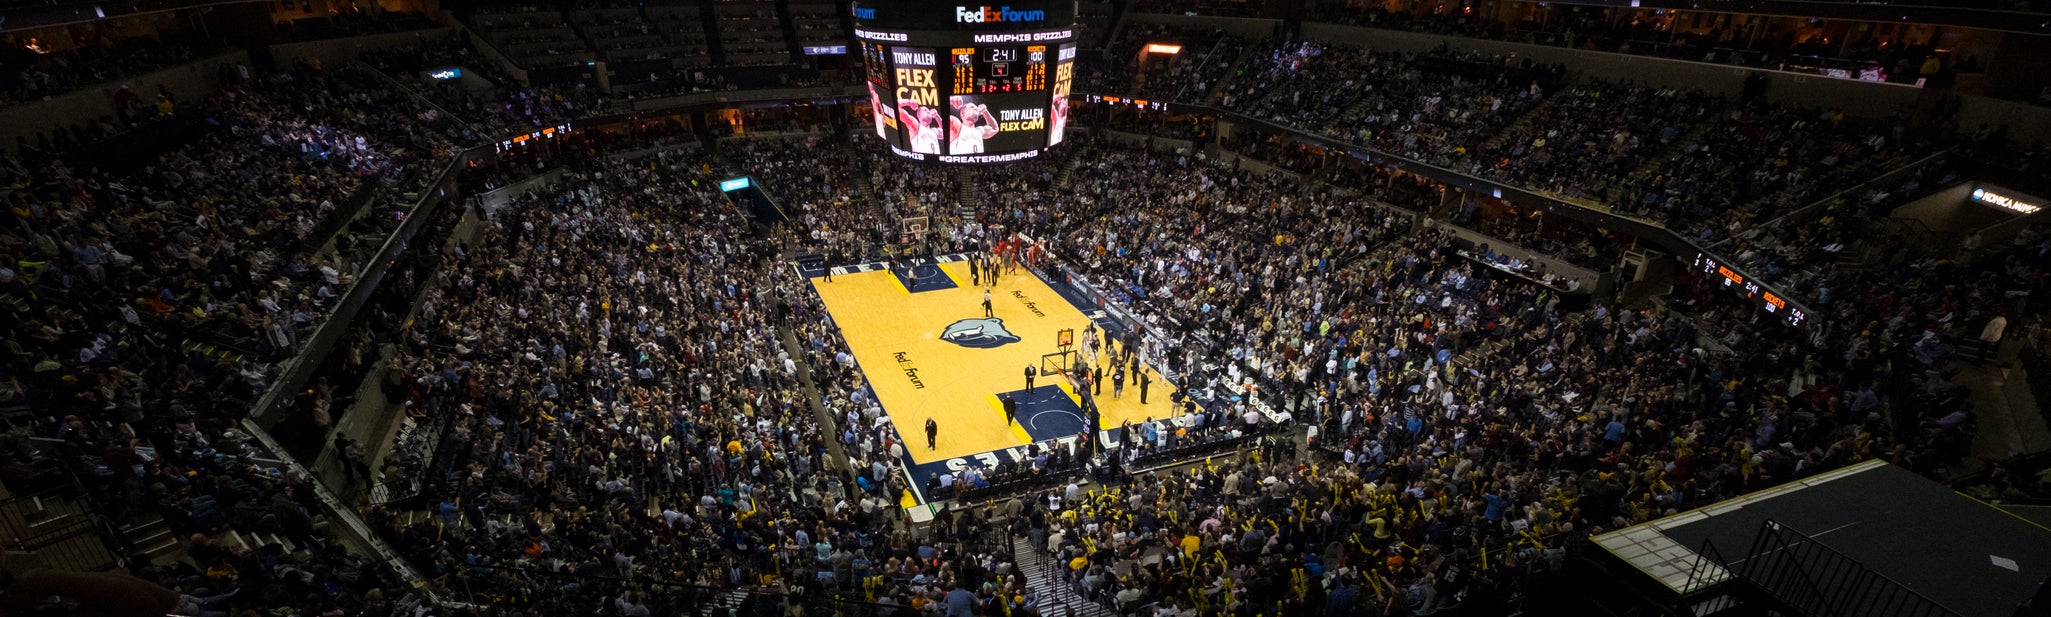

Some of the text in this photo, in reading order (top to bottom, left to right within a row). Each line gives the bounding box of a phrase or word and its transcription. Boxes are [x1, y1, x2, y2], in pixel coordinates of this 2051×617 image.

[956, 6, 1045, 22] FedExForum
[865, 31, 908, 41] GRIZZLIES
[974, 30, 1072, 43] MEMPHIS GRIZZLIES
[893, 52, 936, 66] TONY ALLEN
[959, 54, 970, 64] 95
[992, 49, 1016, 61] 2:41
[1030, 52, 1043, 61] 100
[896, 68, 936, 88] FLEX
[1056, 62, 1073, 82] FLEX
[1053, 79, 1072, 98] CAM
[896, 86, 939, 106] CAM
[1000, 108, 1043, 121] TONY ALLEN
[1000, 117, 1044, 132] FLEX CAM
[939, 149, 1038, 163] #GREATERMEMPHIS
[1982, 192, 2012, 208] KONICA
